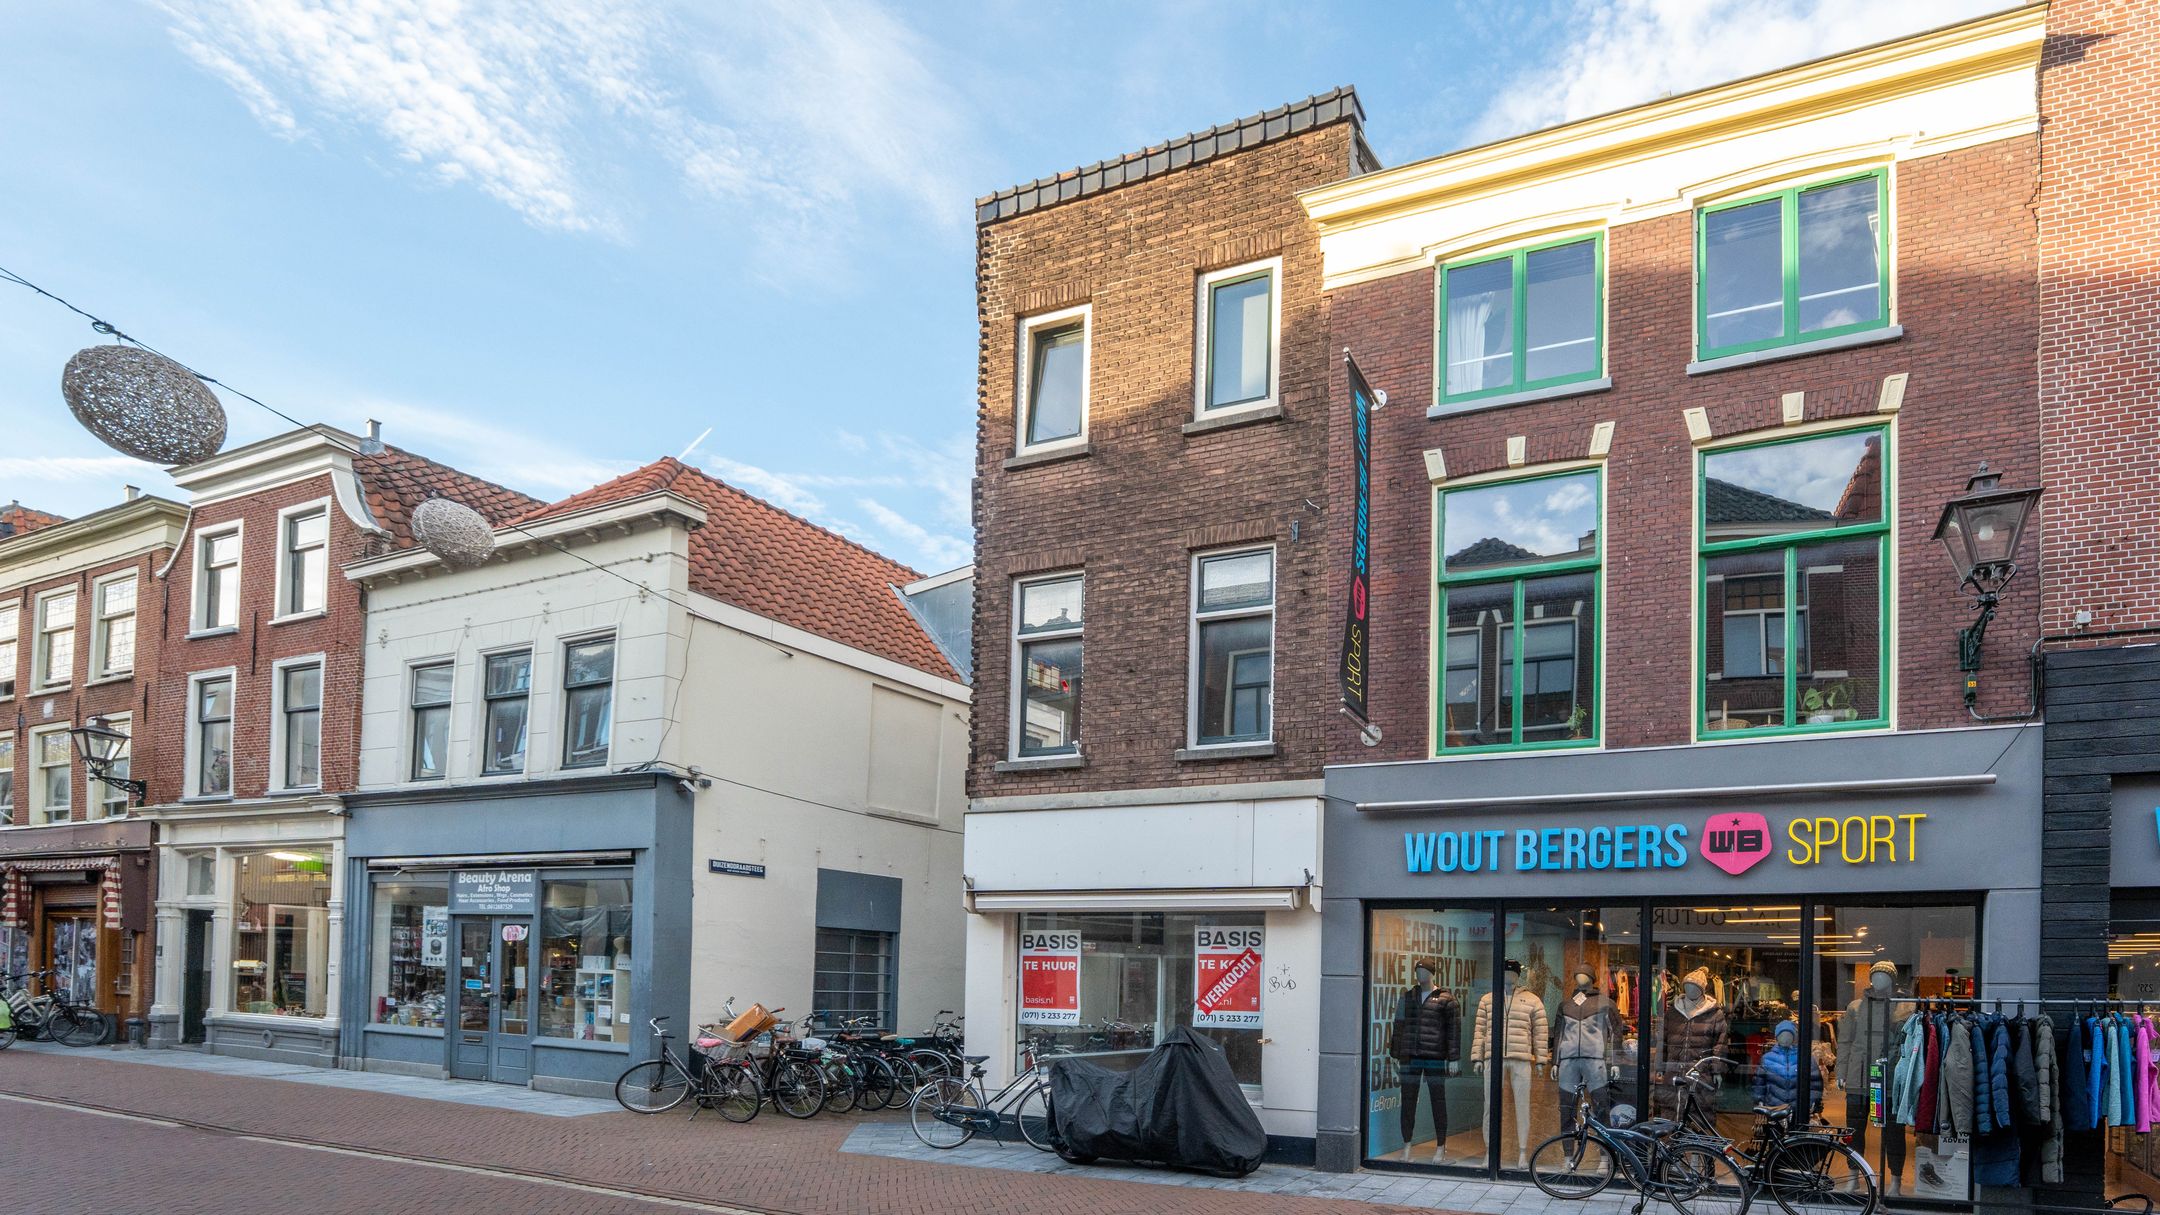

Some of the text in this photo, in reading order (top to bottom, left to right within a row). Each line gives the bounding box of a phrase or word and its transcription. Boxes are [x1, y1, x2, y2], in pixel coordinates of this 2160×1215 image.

[1355, 389, 1368, 575] WOUT BERGERS
[1346, 624, 1362, 702] SPORT
[1787, 813, 1928, 865] SPORT
[1404, 823, 1688, 873] WOUT BERGERS
[458, 870, 532, 885] Beauty Arena
[477, 884, 511, 893] Afro Shop
[1023, 934, 1078, 950] BASIS
[1198, 930, 1262, 947] BASIS
[1384, 916, 1445, 954] TREATED
[1448, 926, 1459, 956] IT
[1024, 961, 1076, 971] TE HUUR
[1199, 959, 1216, 970] TE
[1374, 951, 1477, 987] LIKE ERY DAY
[1201, 953, 1256, 1008] VERKOCHT
[1025, 996, 1053, 1004] basis.nl
[1021, 1012, 1040, 1020] (071)
[1062, 1012, 1076, 1020] 277
[1197, 1014, 1217, 1023] (071)
[1244, 1015, 1260, 1023] 277
[1370, 1095, 1397, 1113] LeBron
